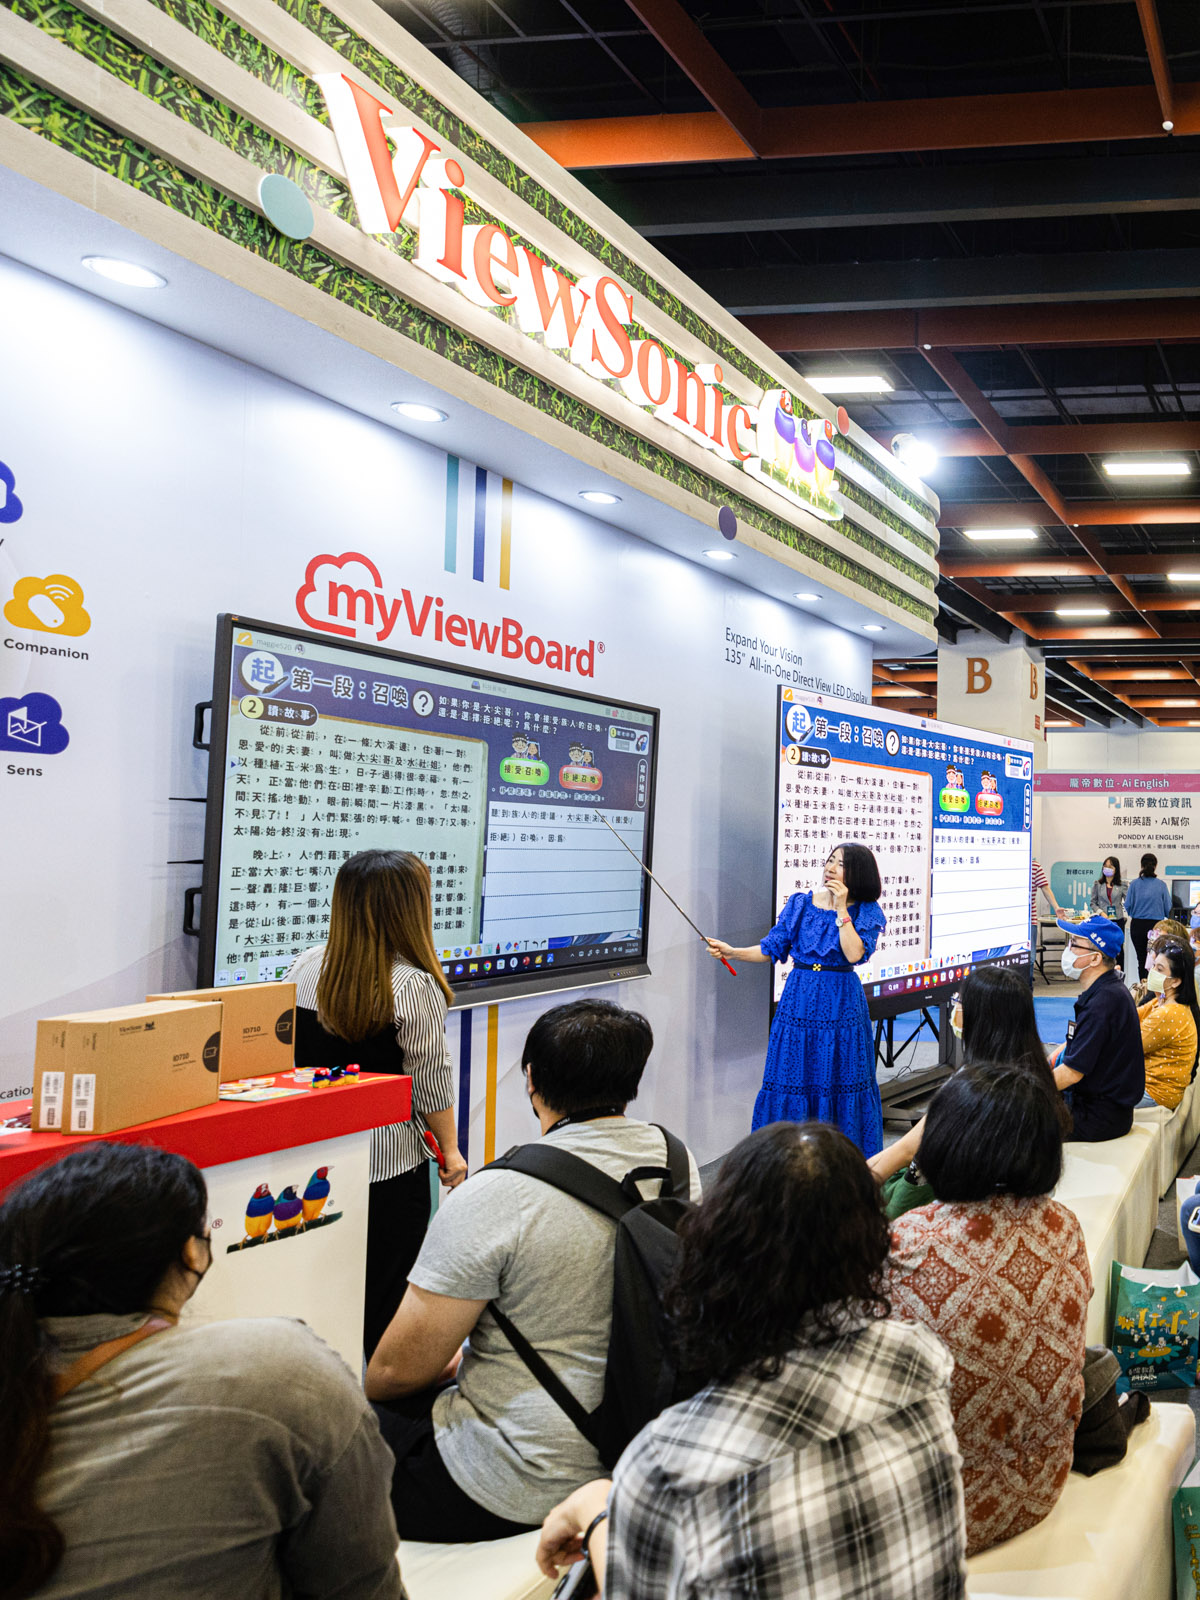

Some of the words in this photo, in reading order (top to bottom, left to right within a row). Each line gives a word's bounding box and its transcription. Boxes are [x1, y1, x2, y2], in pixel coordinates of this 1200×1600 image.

[332, 72, 759, 463] ViewSonic
[3, 638, 90, 661] Companion
[725, 627, 758, 650] Expand
[760, 639, 778, 657] Your
[780, 646, 803, 666] Vision
[250, 657, 276, 685] 起
[749, 656, 791, 681] All-in-One
[792, 669, 814, 688] Direct
[815, 677, 831, 694] View
[832, 682, 845, 697] LED
[846, 687, 868, 704] Display
[965, 657, 992, 694] B
[1029, 663, 1038, 700] B
[291, 667, 409, 708] 第一段：召喚
[6, 764, 43, 777] Sens
[1121, 778, 1132, 788] Ai
[1133, 778, 1170, 790] English
[252, 849, 361, 861] 晚上，人們藉著
[231, 866, 341, 878] 正當大家七嘴八
